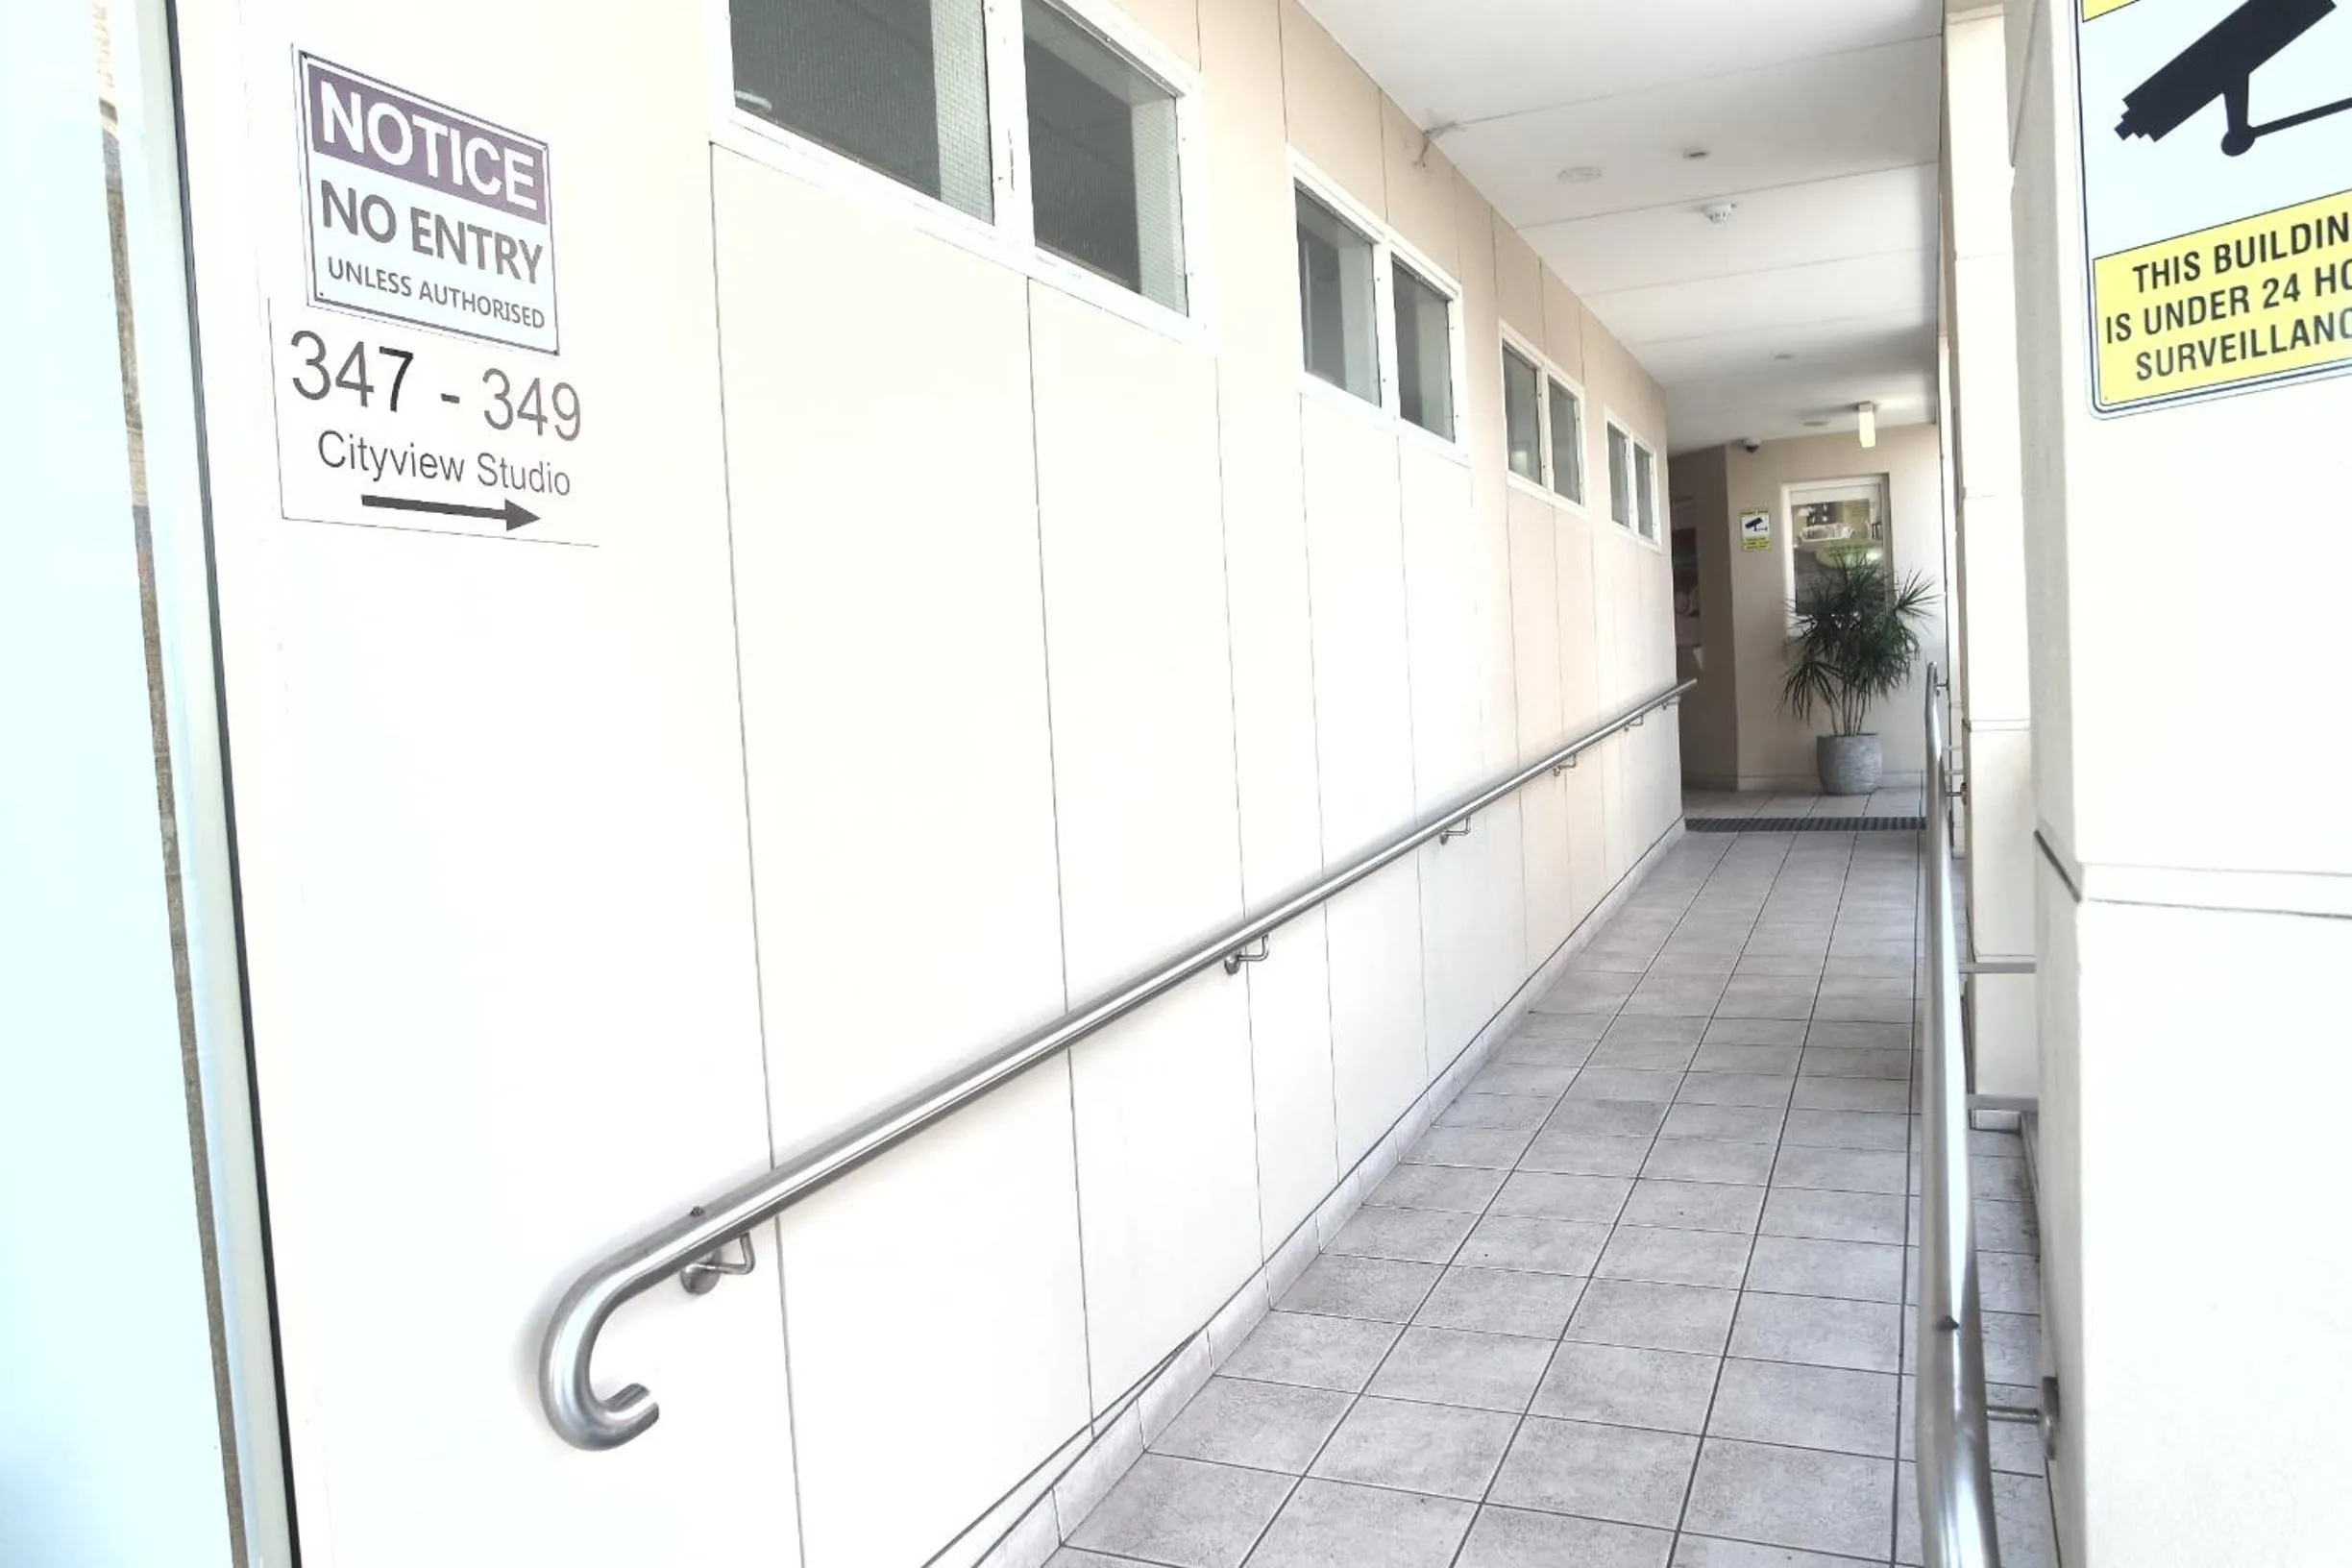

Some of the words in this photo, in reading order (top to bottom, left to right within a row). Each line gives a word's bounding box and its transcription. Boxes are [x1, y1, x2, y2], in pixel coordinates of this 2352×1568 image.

[321, 81, 537, 210] NOTICE
[321, 180, 397, 243] NO
[410, 207, 543, 284] ENTRY
[2132, 251, 2200, 293] THIS
[2214, 211, 2350, 274] BUILDIN
[328, 257, 412, 297] UNLESS
[419, 281, 545, 329] AUTHORISED
[2106, 313, 2132, 344] IS
[2144, 285, 2249, 335] UNDER
[2263, 273, 2300, 309] 24
[290, 330, 412, 412] 347
[482, 368, 581, 441] 349
[318, 429, 465, 482] Cityview
[477, 453, 571, 496] Studio
